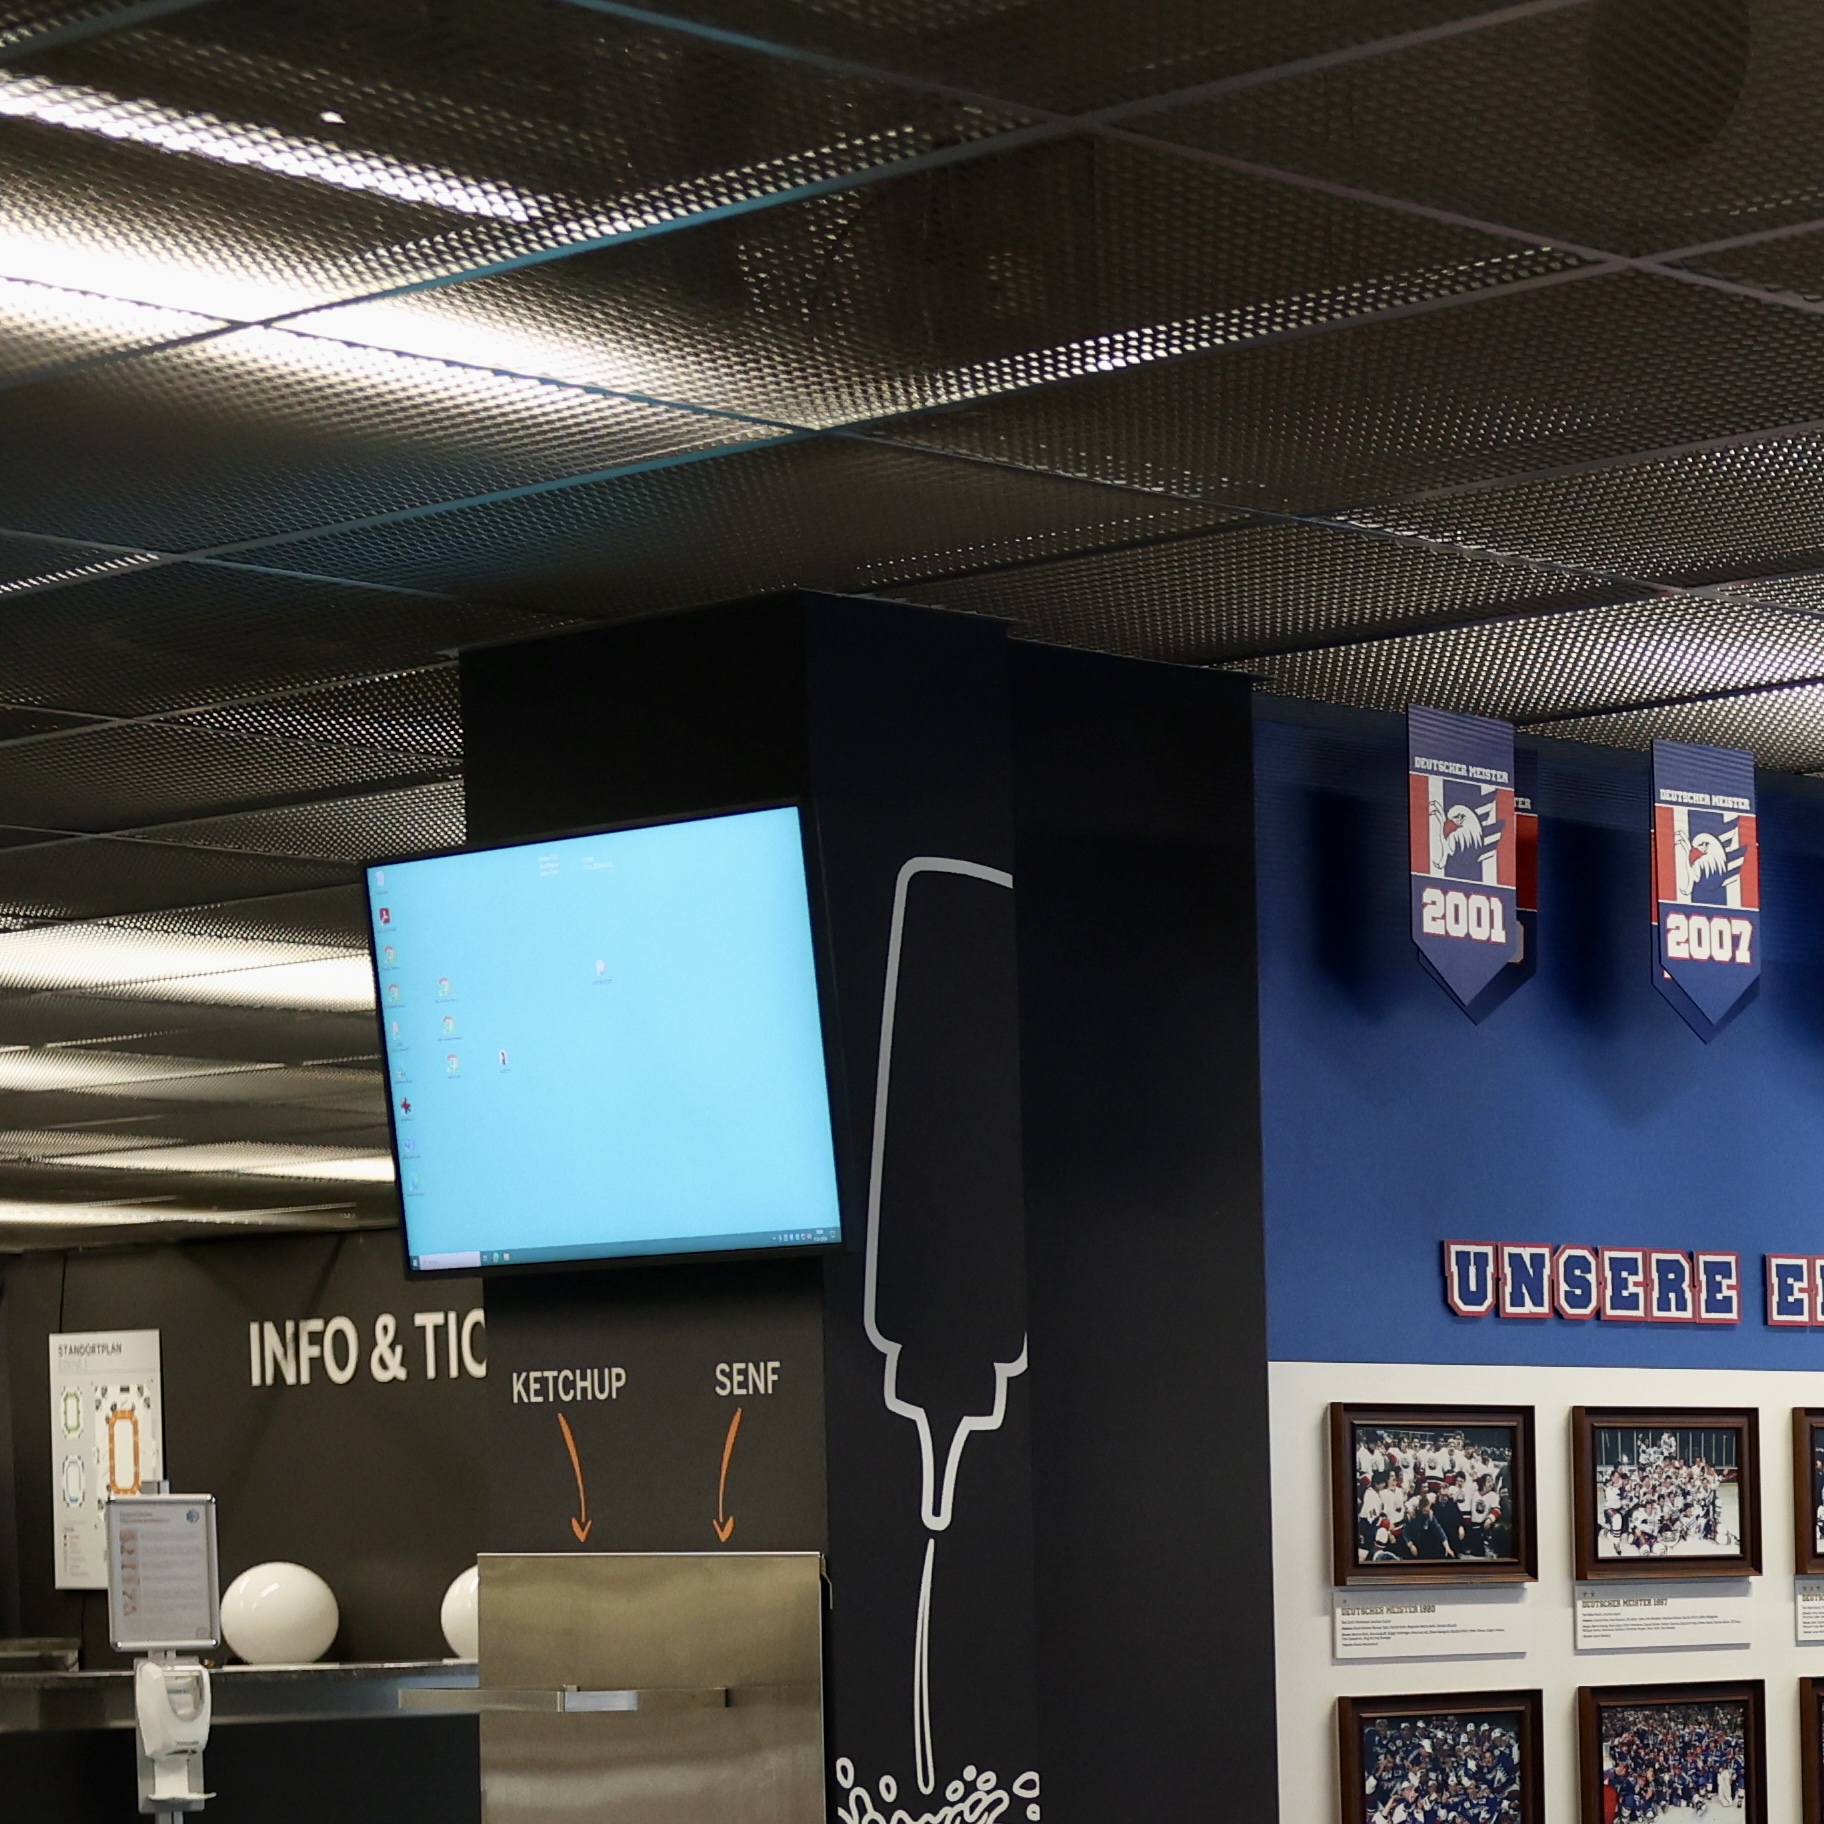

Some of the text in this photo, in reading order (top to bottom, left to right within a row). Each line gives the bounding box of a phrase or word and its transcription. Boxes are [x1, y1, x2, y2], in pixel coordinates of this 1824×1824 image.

[1414, 756, 1509, 783] DEUTSCHER MEISTER
[1659, 788, 1751, 811] DEUTSCHER MEISTER
[1421, 886, 1507, 944] 2001
[1666, 911, 1753, 965] 2007
[1443, 1239, 1741, 1324] UNSERE
[250, 1315, 358, 1387] INFO
[370, 1313, 408, 1381] &
[512, 1366, 627, 1404] KETCHUP
[714, 1361, 782, 1396] SENF
